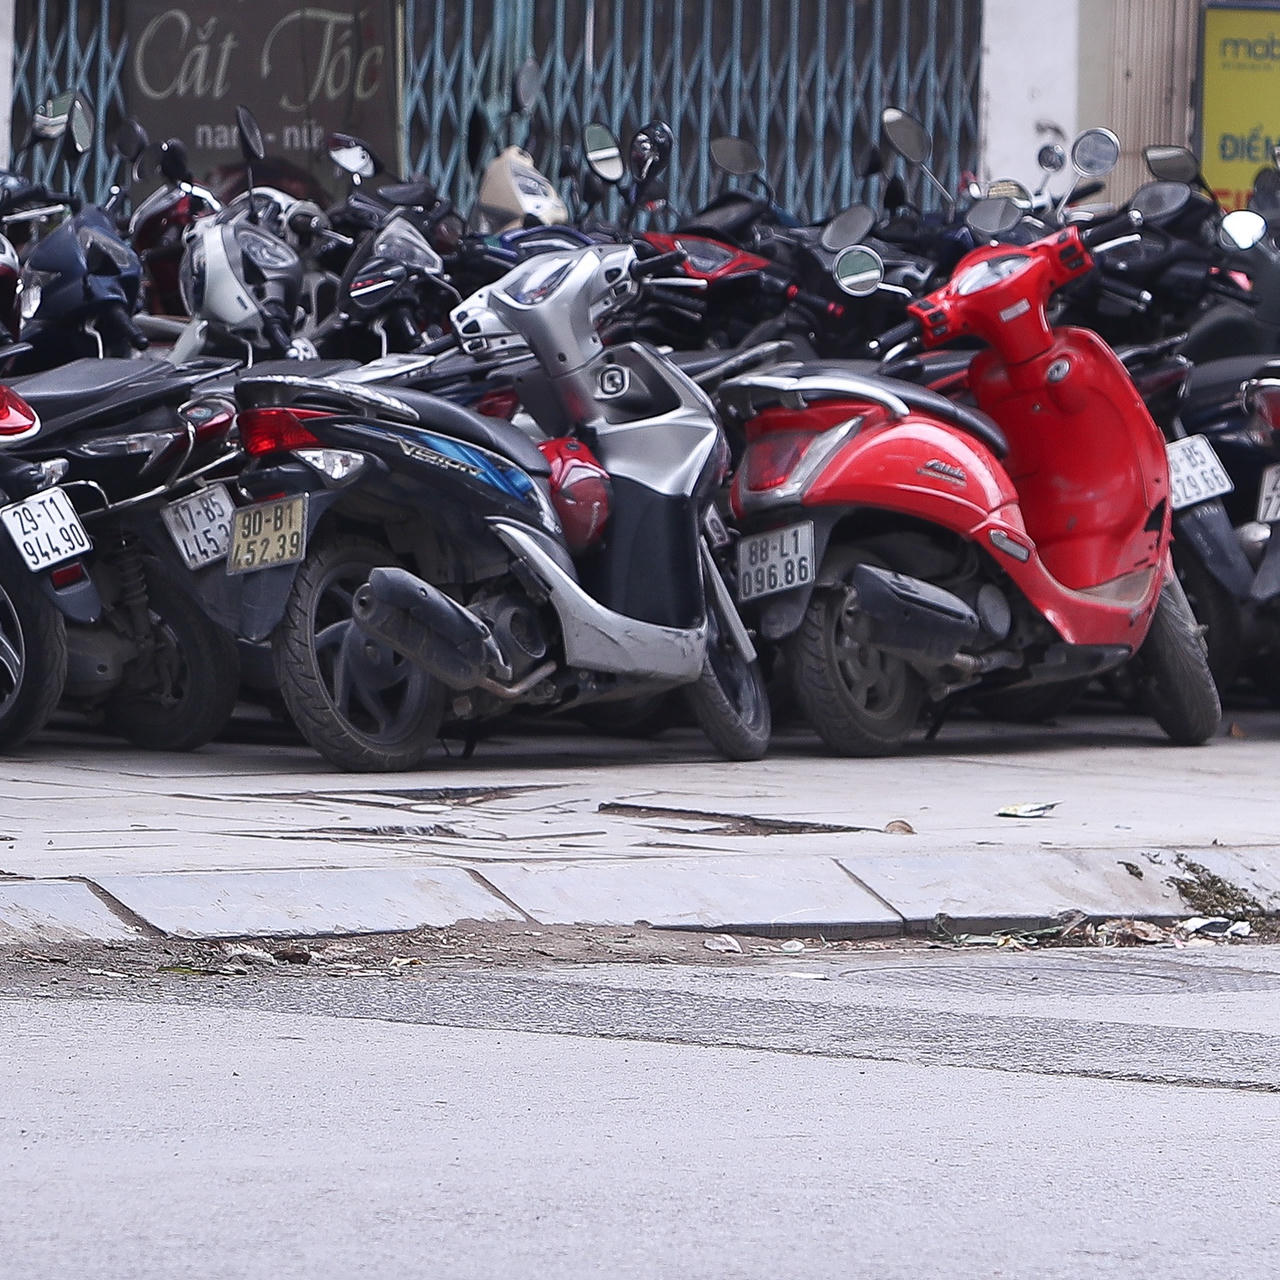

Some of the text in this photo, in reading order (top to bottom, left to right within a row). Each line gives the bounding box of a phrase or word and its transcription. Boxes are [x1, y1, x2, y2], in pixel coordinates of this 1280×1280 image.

[133, 8, 239, 102] Cắt
[13, 496, 65, 536] 29-T1
[242, 504, 295, 539] 90-B1
[23, 522, 85, 566] 944.90
[749, 530, 800, 565] 88-L1
[743, 557, 809, 599] 096.86
